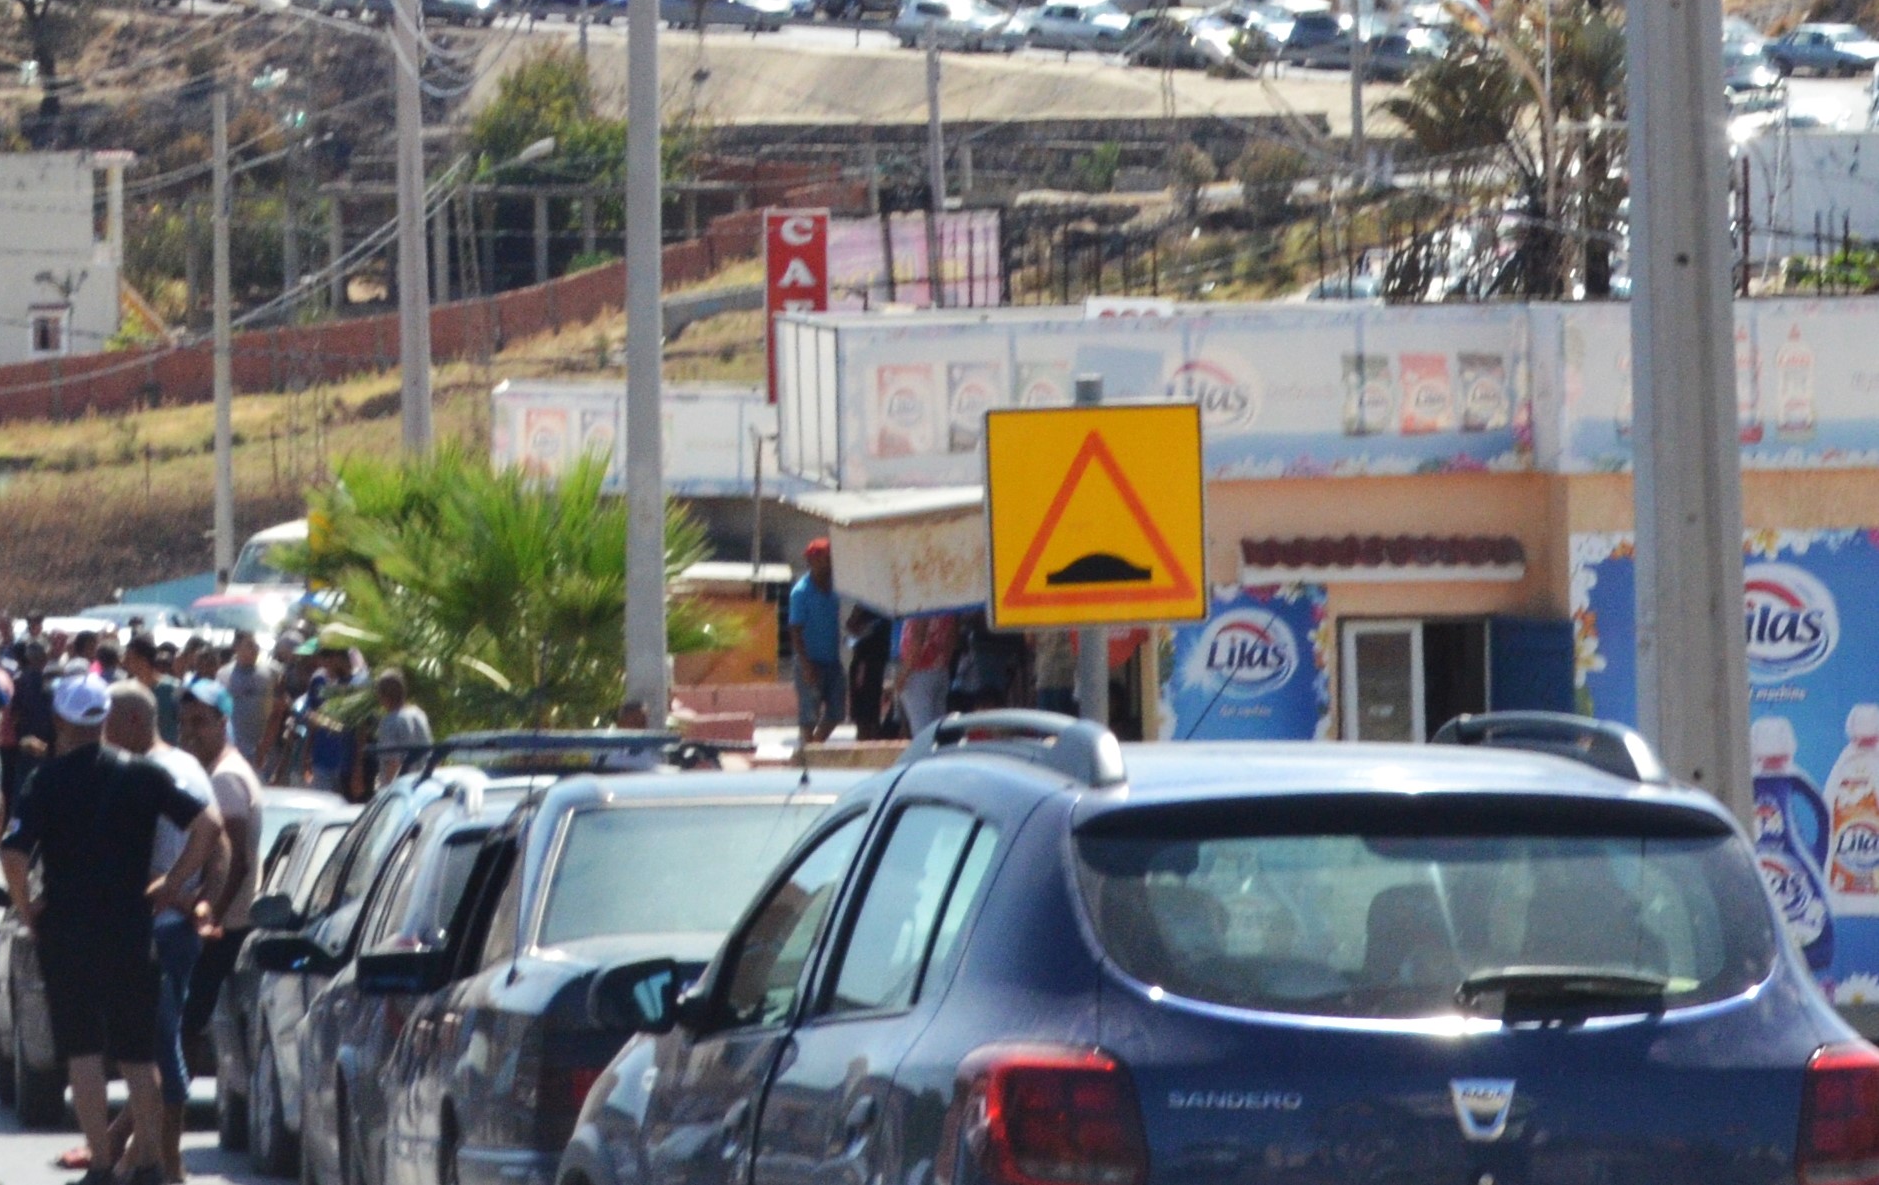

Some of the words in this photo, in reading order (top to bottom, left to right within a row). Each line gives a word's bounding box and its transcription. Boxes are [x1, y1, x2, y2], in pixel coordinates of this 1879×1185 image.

[1745, 600, 1824, 644] ilas
[1206, 635, 1287, 670] Lilas
[1835, 830, 1879, 854] Lila
[1169, 1090, 1304, 1110] SANDERO
